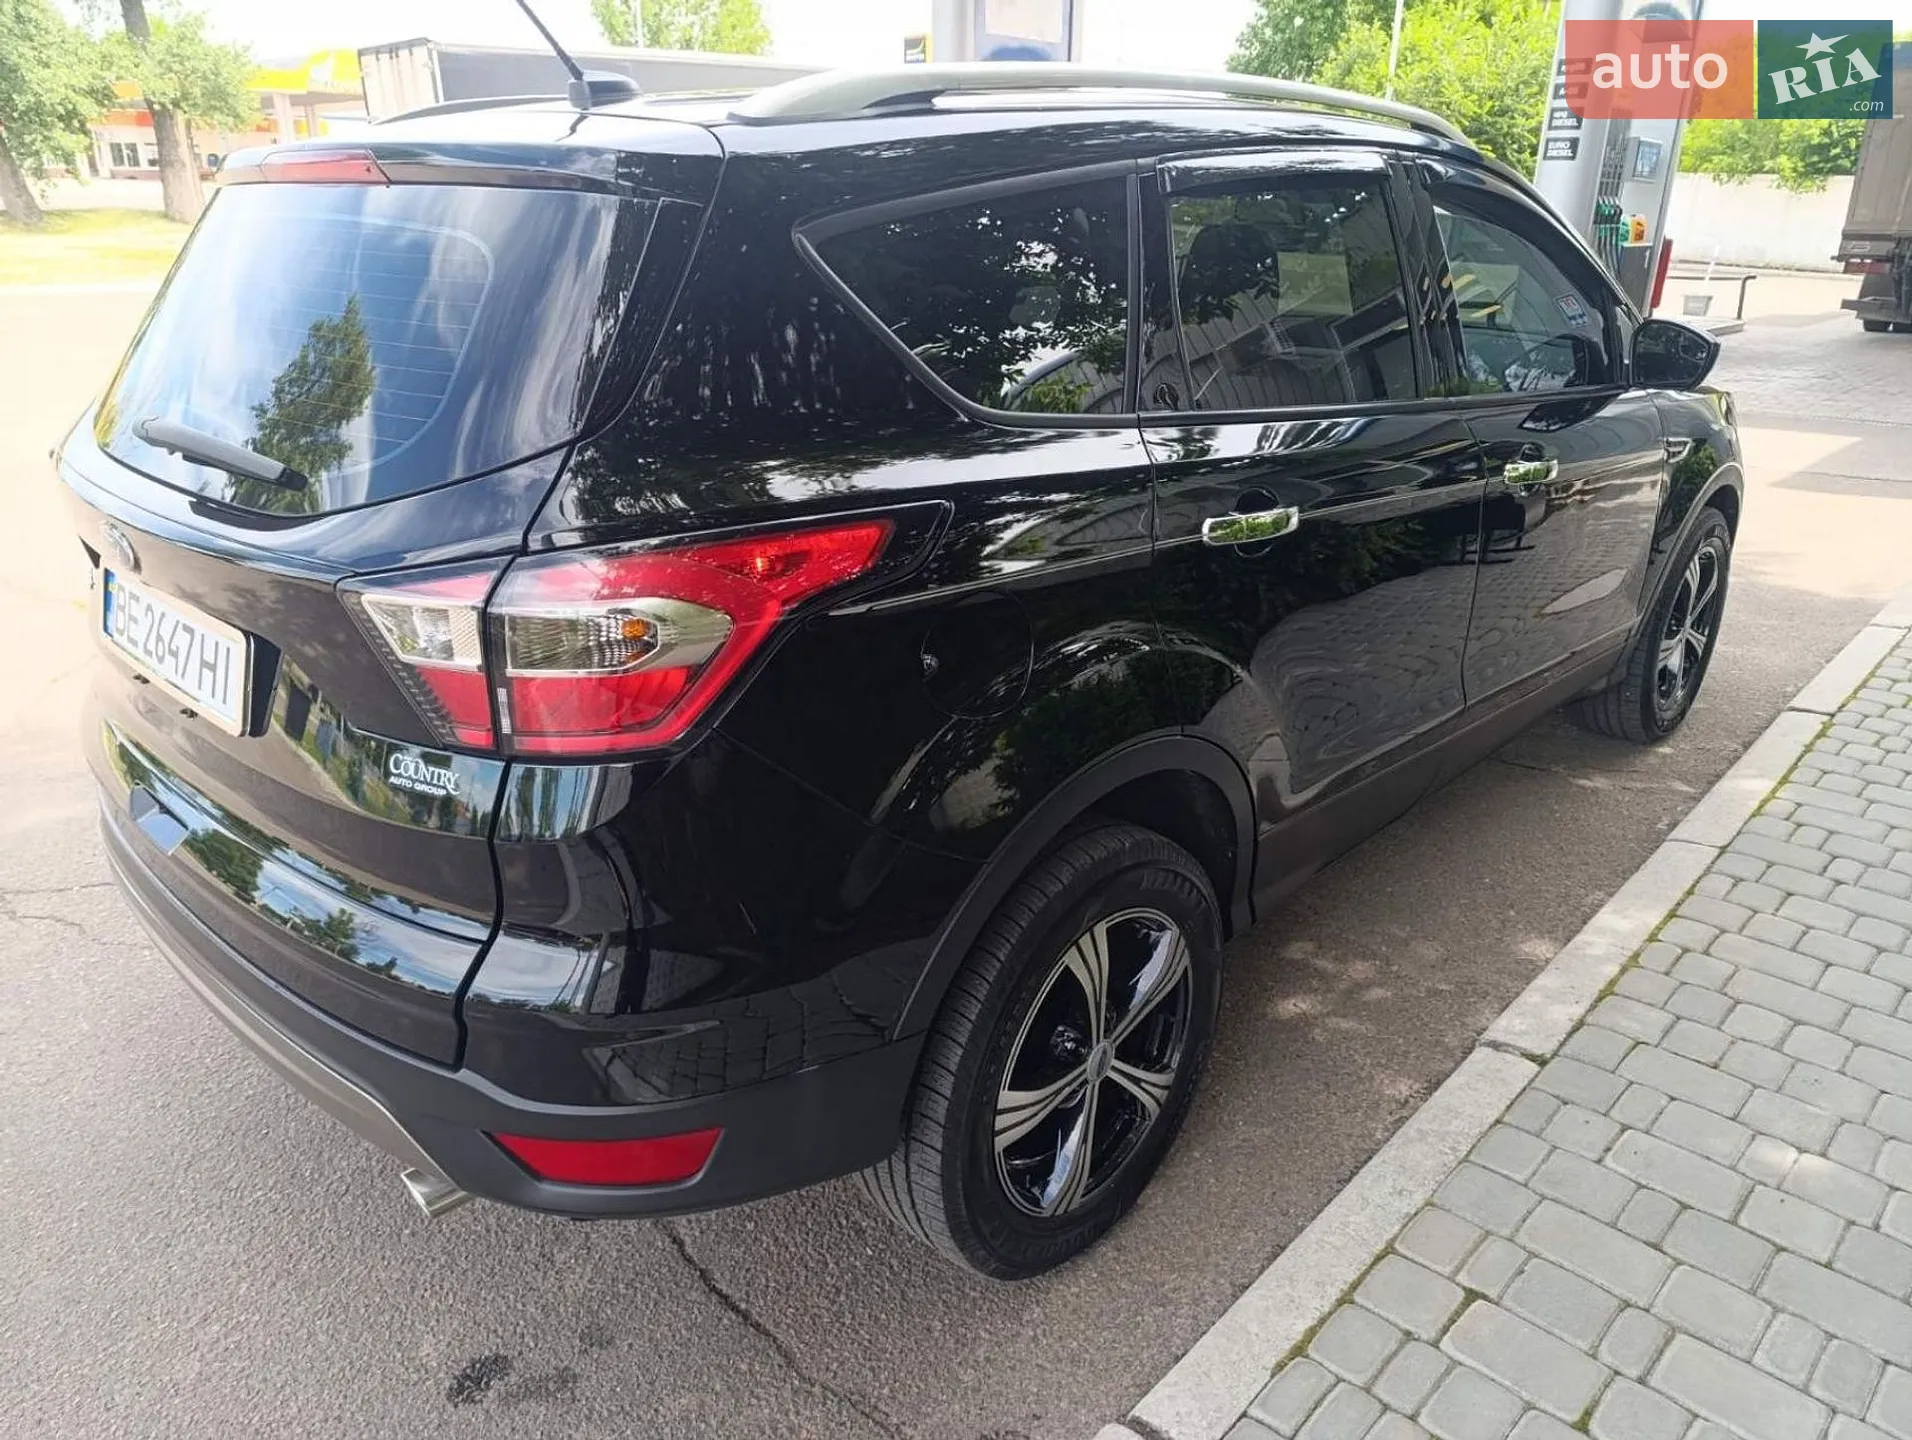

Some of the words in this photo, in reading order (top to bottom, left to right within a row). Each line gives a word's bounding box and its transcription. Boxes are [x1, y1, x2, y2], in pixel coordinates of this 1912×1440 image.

[389, 776, 412, 787] AUTO
[413, 782, 448, 796] GROUP
[390, 754, 460, 794] COUNTRY
